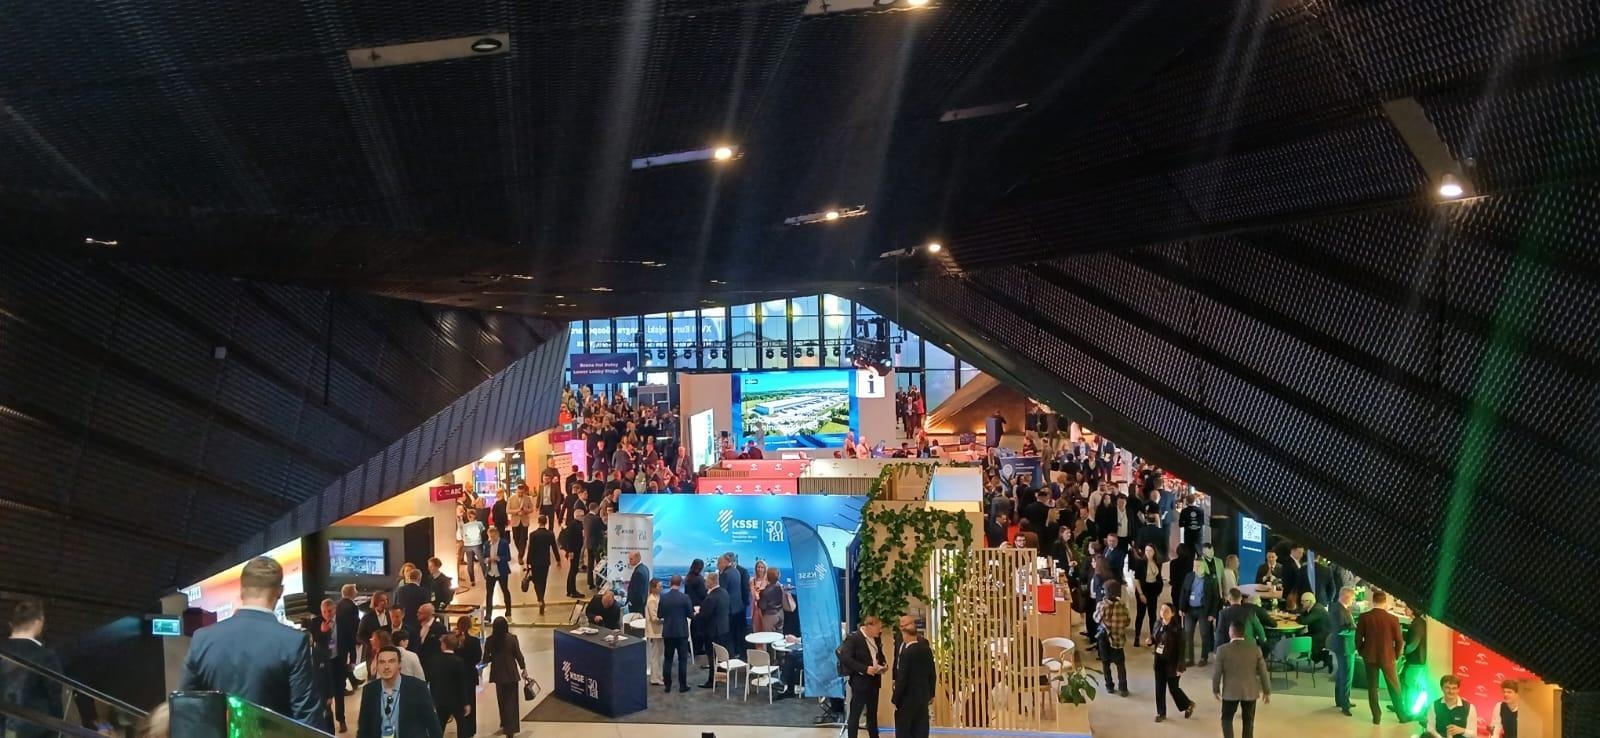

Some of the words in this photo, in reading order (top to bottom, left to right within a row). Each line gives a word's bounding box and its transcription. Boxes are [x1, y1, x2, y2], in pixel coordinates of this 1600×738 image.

[732, 519, 759, 529] KSSE
[765, 520, 783, 533] 30
[768, 531, 785, 542] lat
[570, 672, 585, 683] KSSE
